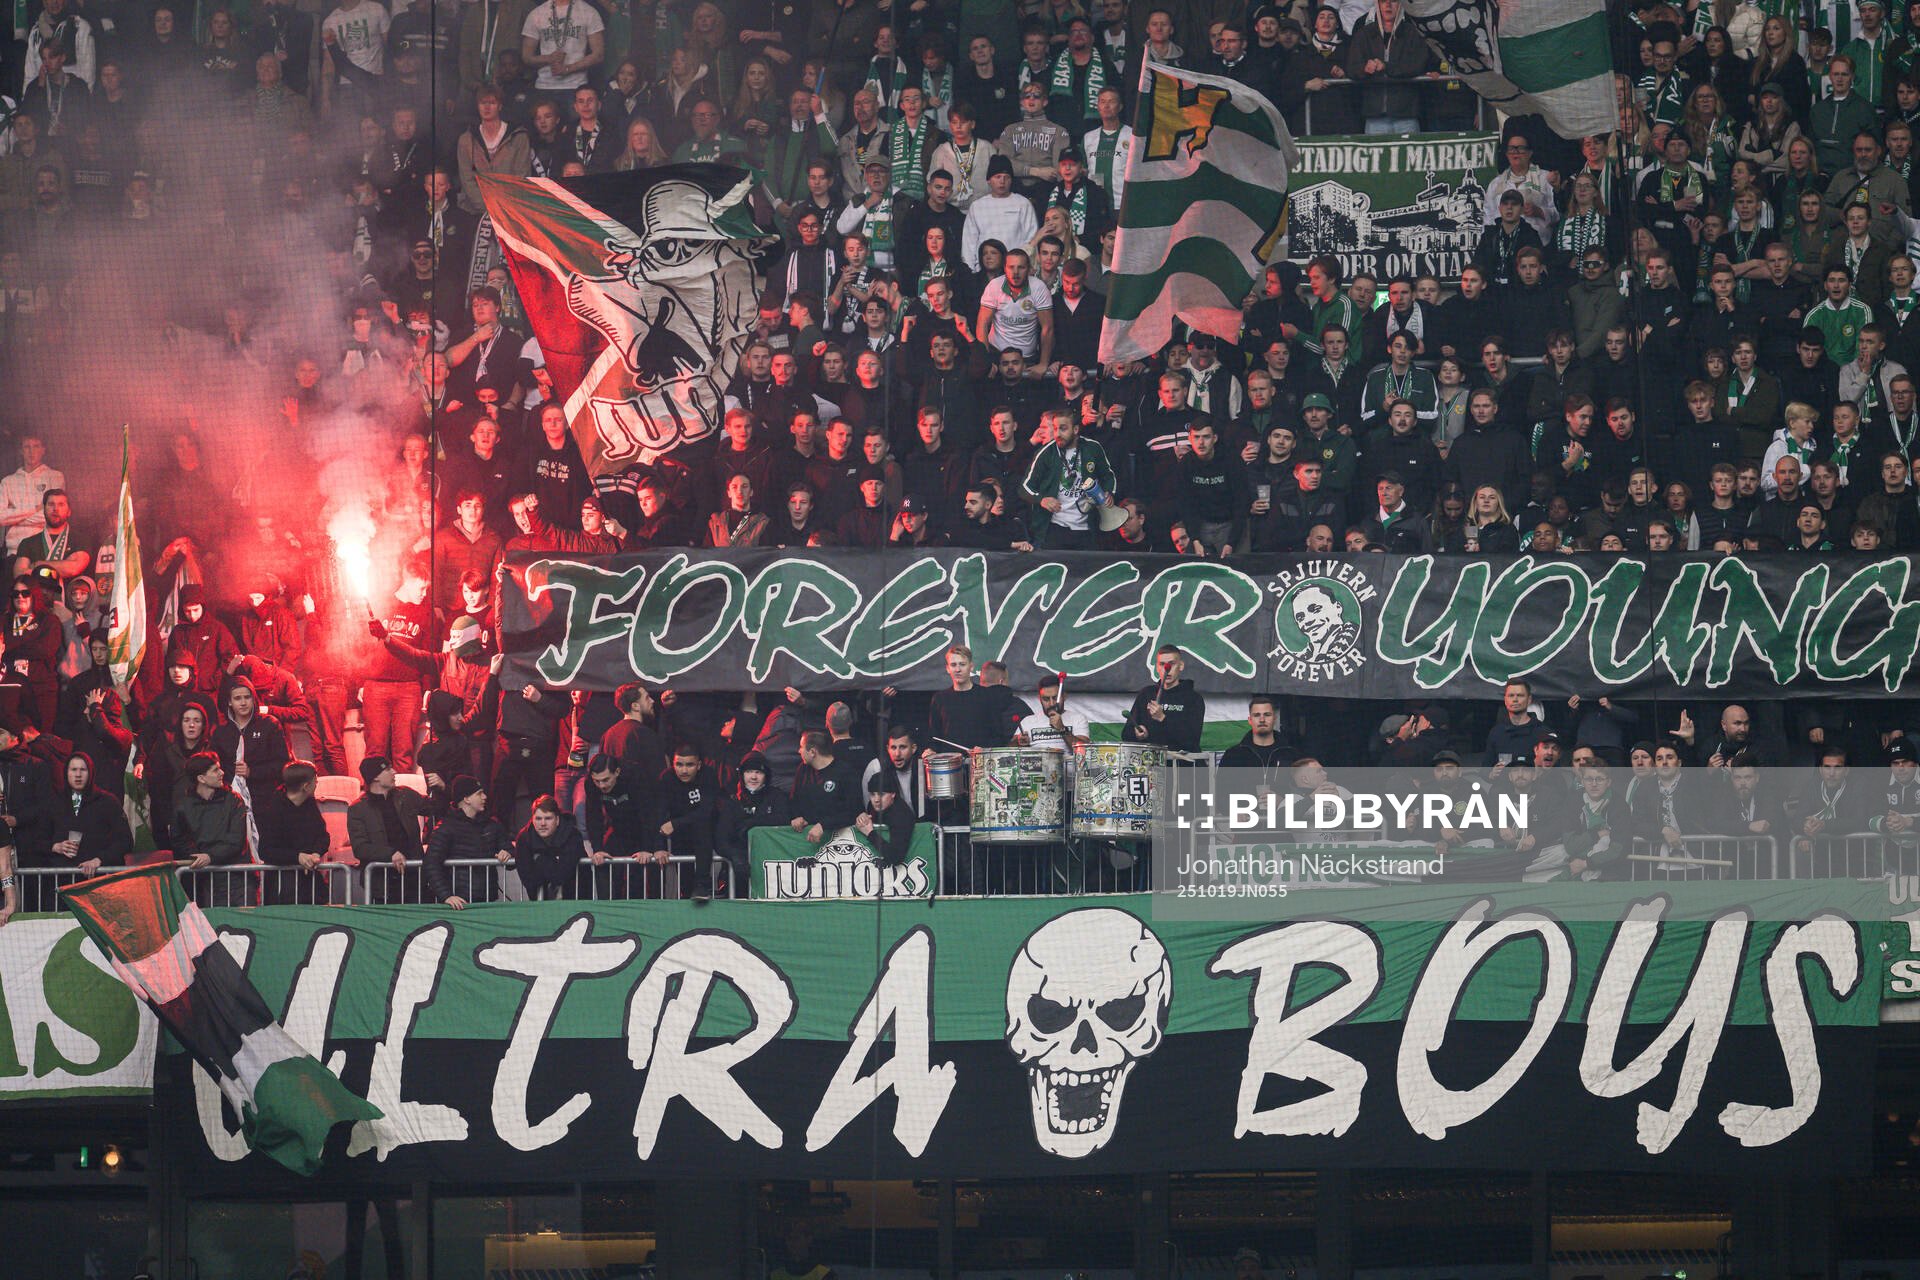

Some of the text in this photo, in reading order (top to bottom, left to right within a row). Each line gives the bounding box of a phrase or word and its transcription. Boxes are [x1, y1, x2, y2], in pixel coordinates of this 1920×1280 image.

[1389, 146, 1400, 173] I
[1405, 141, 1497, 172] MARKEN
[1309, 251, 1378, 279] DER
[1385, 253, 1418, 278] OM
[1267, 560, 1378, 602] SPJUVERN
[525, 552, 1920, 693] FOREVER YOUNG
[1266, 644, 1367, 682] FOREVER
[190, 895, 1862, 1162] ULTRA BOYS
